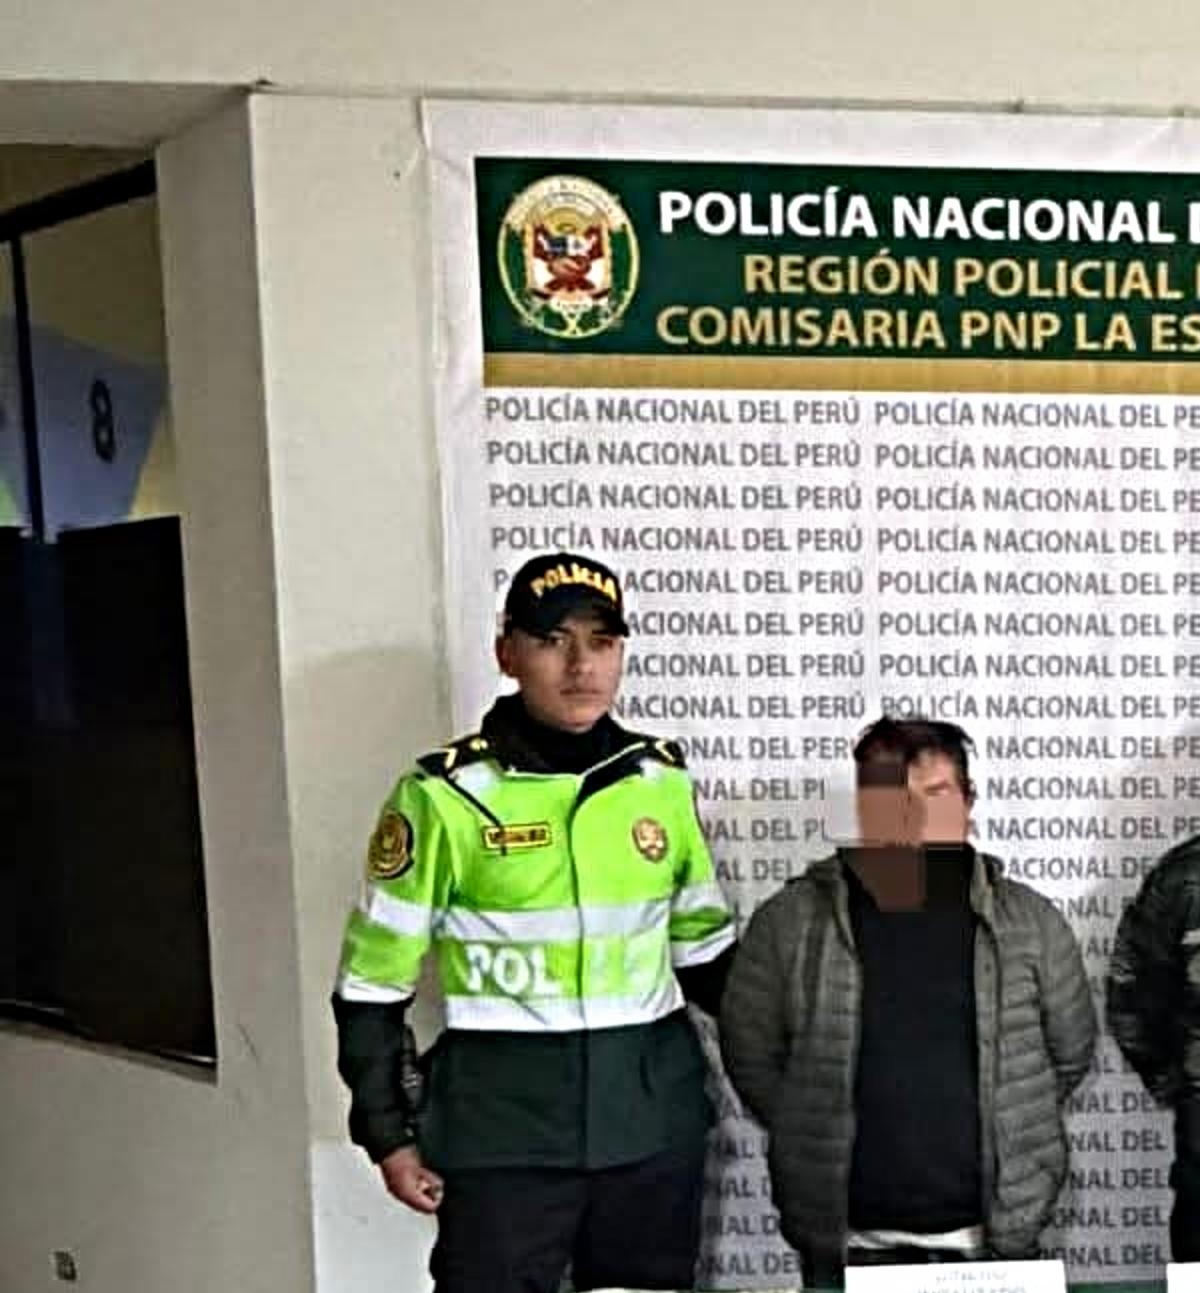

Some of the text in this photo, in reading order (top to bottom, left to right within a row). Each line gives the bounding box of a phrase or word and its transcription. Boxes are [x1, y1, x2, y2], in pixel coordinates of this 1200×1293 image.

[659, 186, 878, 237] POLICÍA
[892, 196, 1176, 243] NACIONAL
[744, 247, 939, 296] REGIÓN
[955, 257, 1184, 300] POLICIAL
[655, 305, 946, 348] COMISARIA
[960, 310, 1062, 350] PNP
[1074, 312, 1137, 352] LA
[485, 390, 860, 425] POLICÍA NACIONAL DEL PERÚ
[874, 395, 975, 426] POLICÍA
[982, 402, 1114, 428] NACIONAL
[1119, 404, 1168, 428] DEL
[486, 434, 861, 468] POLICÍA NACIONAL DEL PERÚ
[875, 438, 976, 469] POLICÍA
[983, 445, 1115, 470] NACIONAL
[1119, 447, 1167, 470] DEL
[489, 477, 862, 510] POLICÍA NACIONAL DEL PERÚ
[876, 480, 976, 511] POLICÍA
[983, 487, 1115, 512] NACIONAL
[1120, 489, 1167, 512] DEL
[491, 520, 863, 552] POLICÍA NACIONAL DEL PERÚ
[877, 522, 977, 553] POLICÍA
[984, 529, 1115, 554] NACIONAL
[1120, 530, 1167, 554] DEL
[624, 565, 863, 594] ACIONAL DEL PERÚ
[878, 564, 978, 595] POLICÍA
[984, 571, 1116, 595] NACIONAL
[1121, 572, 1167, 595] DEL
[627, 607, 864, 636] ACIONAL DEL PERÚ
[879, 606, 978, 636] POLICÍA
[985, 613, 1116, 636] NACIONAL
[1121, 613, 1167, 637] DEL
[627, 649, 864, 678] ACIONAL DEL PERÚ
[879, 648, 978, 678] POLICÍA
[986, 654, 1116, 678] NACIONAL
[1121, 654, 1167, 678] DEL
[747, 695, 796, 719] DEL
[801, 690, 865, 719] PERÚ
[986, 695, 1116, 719] NACIONAL
[1121, 695, 1167, 718] DEL
[749, 736, 796, 760] DEL
[802, 736, 850, 760] PER
[986, 736, 1116, 760] NACIONAL
[1121, 736, 1167, 759] DEL
[750, 778, 798, 801] DEL
[987, 777, 1115, 800] NACIONAL
[1120, 776, 1167, 799] DEL
[751, 818, 798, 842] DEL
[987, 817, 1116, 841] NACIONAL
[1120, 817, 1168, 839] DEL
[1008, 857, 1116, 880] ACIONAL
